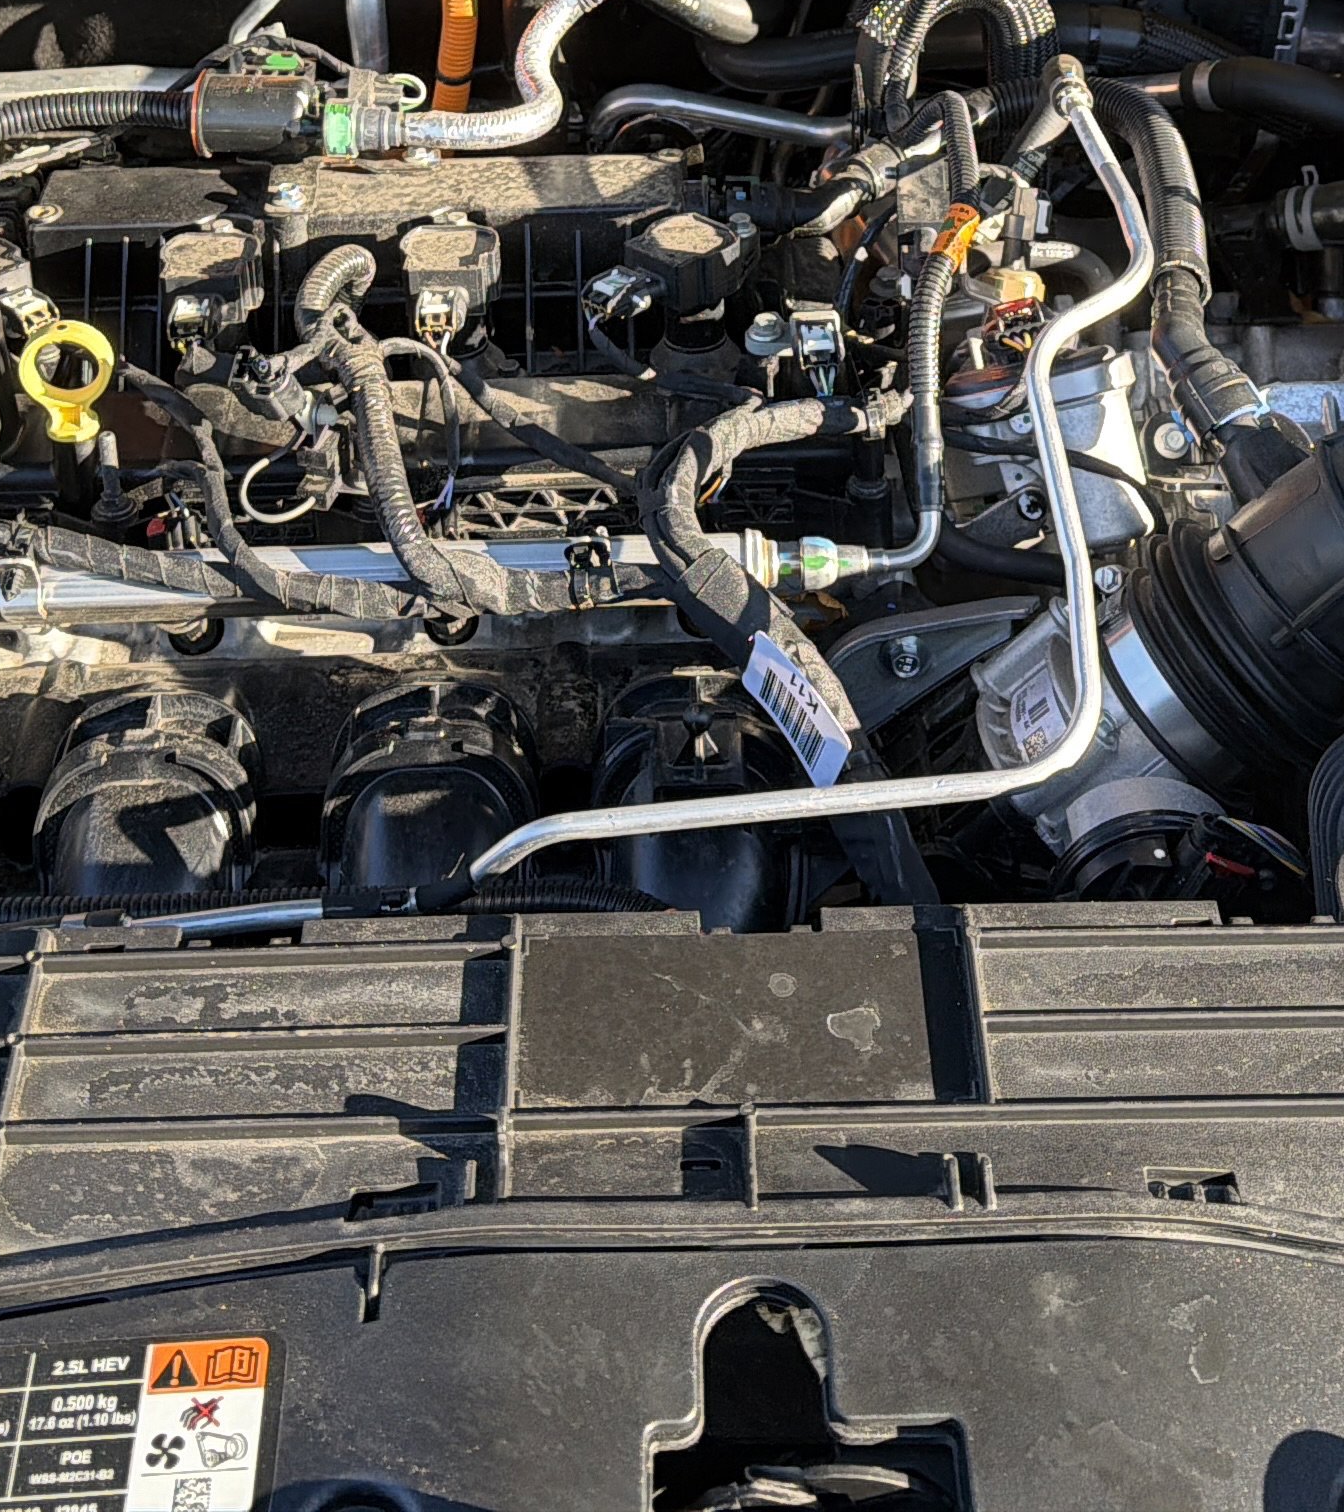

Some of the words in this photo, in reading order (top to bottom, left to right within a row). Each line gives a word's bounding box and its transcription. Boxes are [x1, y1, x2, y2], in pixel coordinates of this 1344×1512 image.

[50, 1359, 89, 1377] 2.5L
[90, 1355, 131, 1373] HEV
[51, 1394, 96, 1414] 0.500
[96, 1393, 119, 1413] kg
[58, 1417, 76, 1429] oz
[76, 1412, 109, 1431] (1.10
[110, 1409, 138, 1428] lbs)
[59, 1448, 94, 1466] POE
